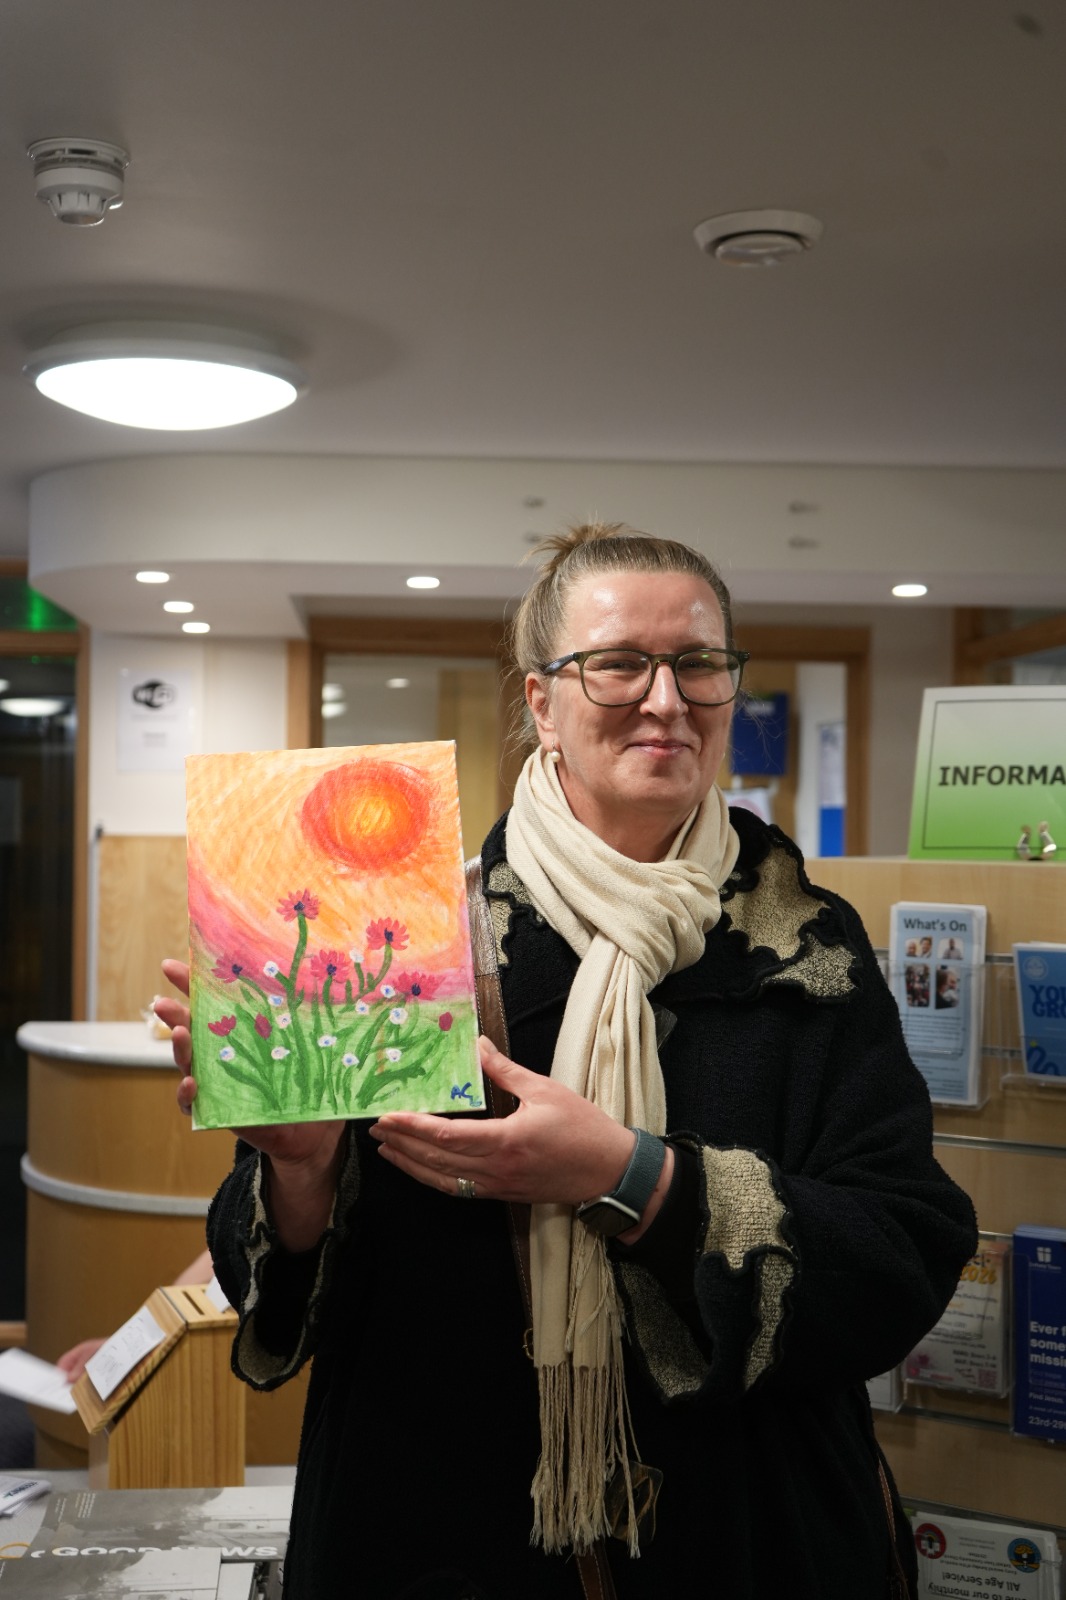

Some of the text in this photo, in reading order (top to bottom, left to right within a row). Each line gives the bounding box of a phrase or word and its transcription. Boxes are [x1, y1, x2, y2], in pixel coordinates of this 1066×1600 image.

[938, 765, 1066, 786] INFORMA
[903, 917, 967, 932] What's On
[1029, 1321, 1059, 1336] Ever
[942, 1572, 1020, 1591] All Age Service!
[928, 1582, 969, 1597] monthly
